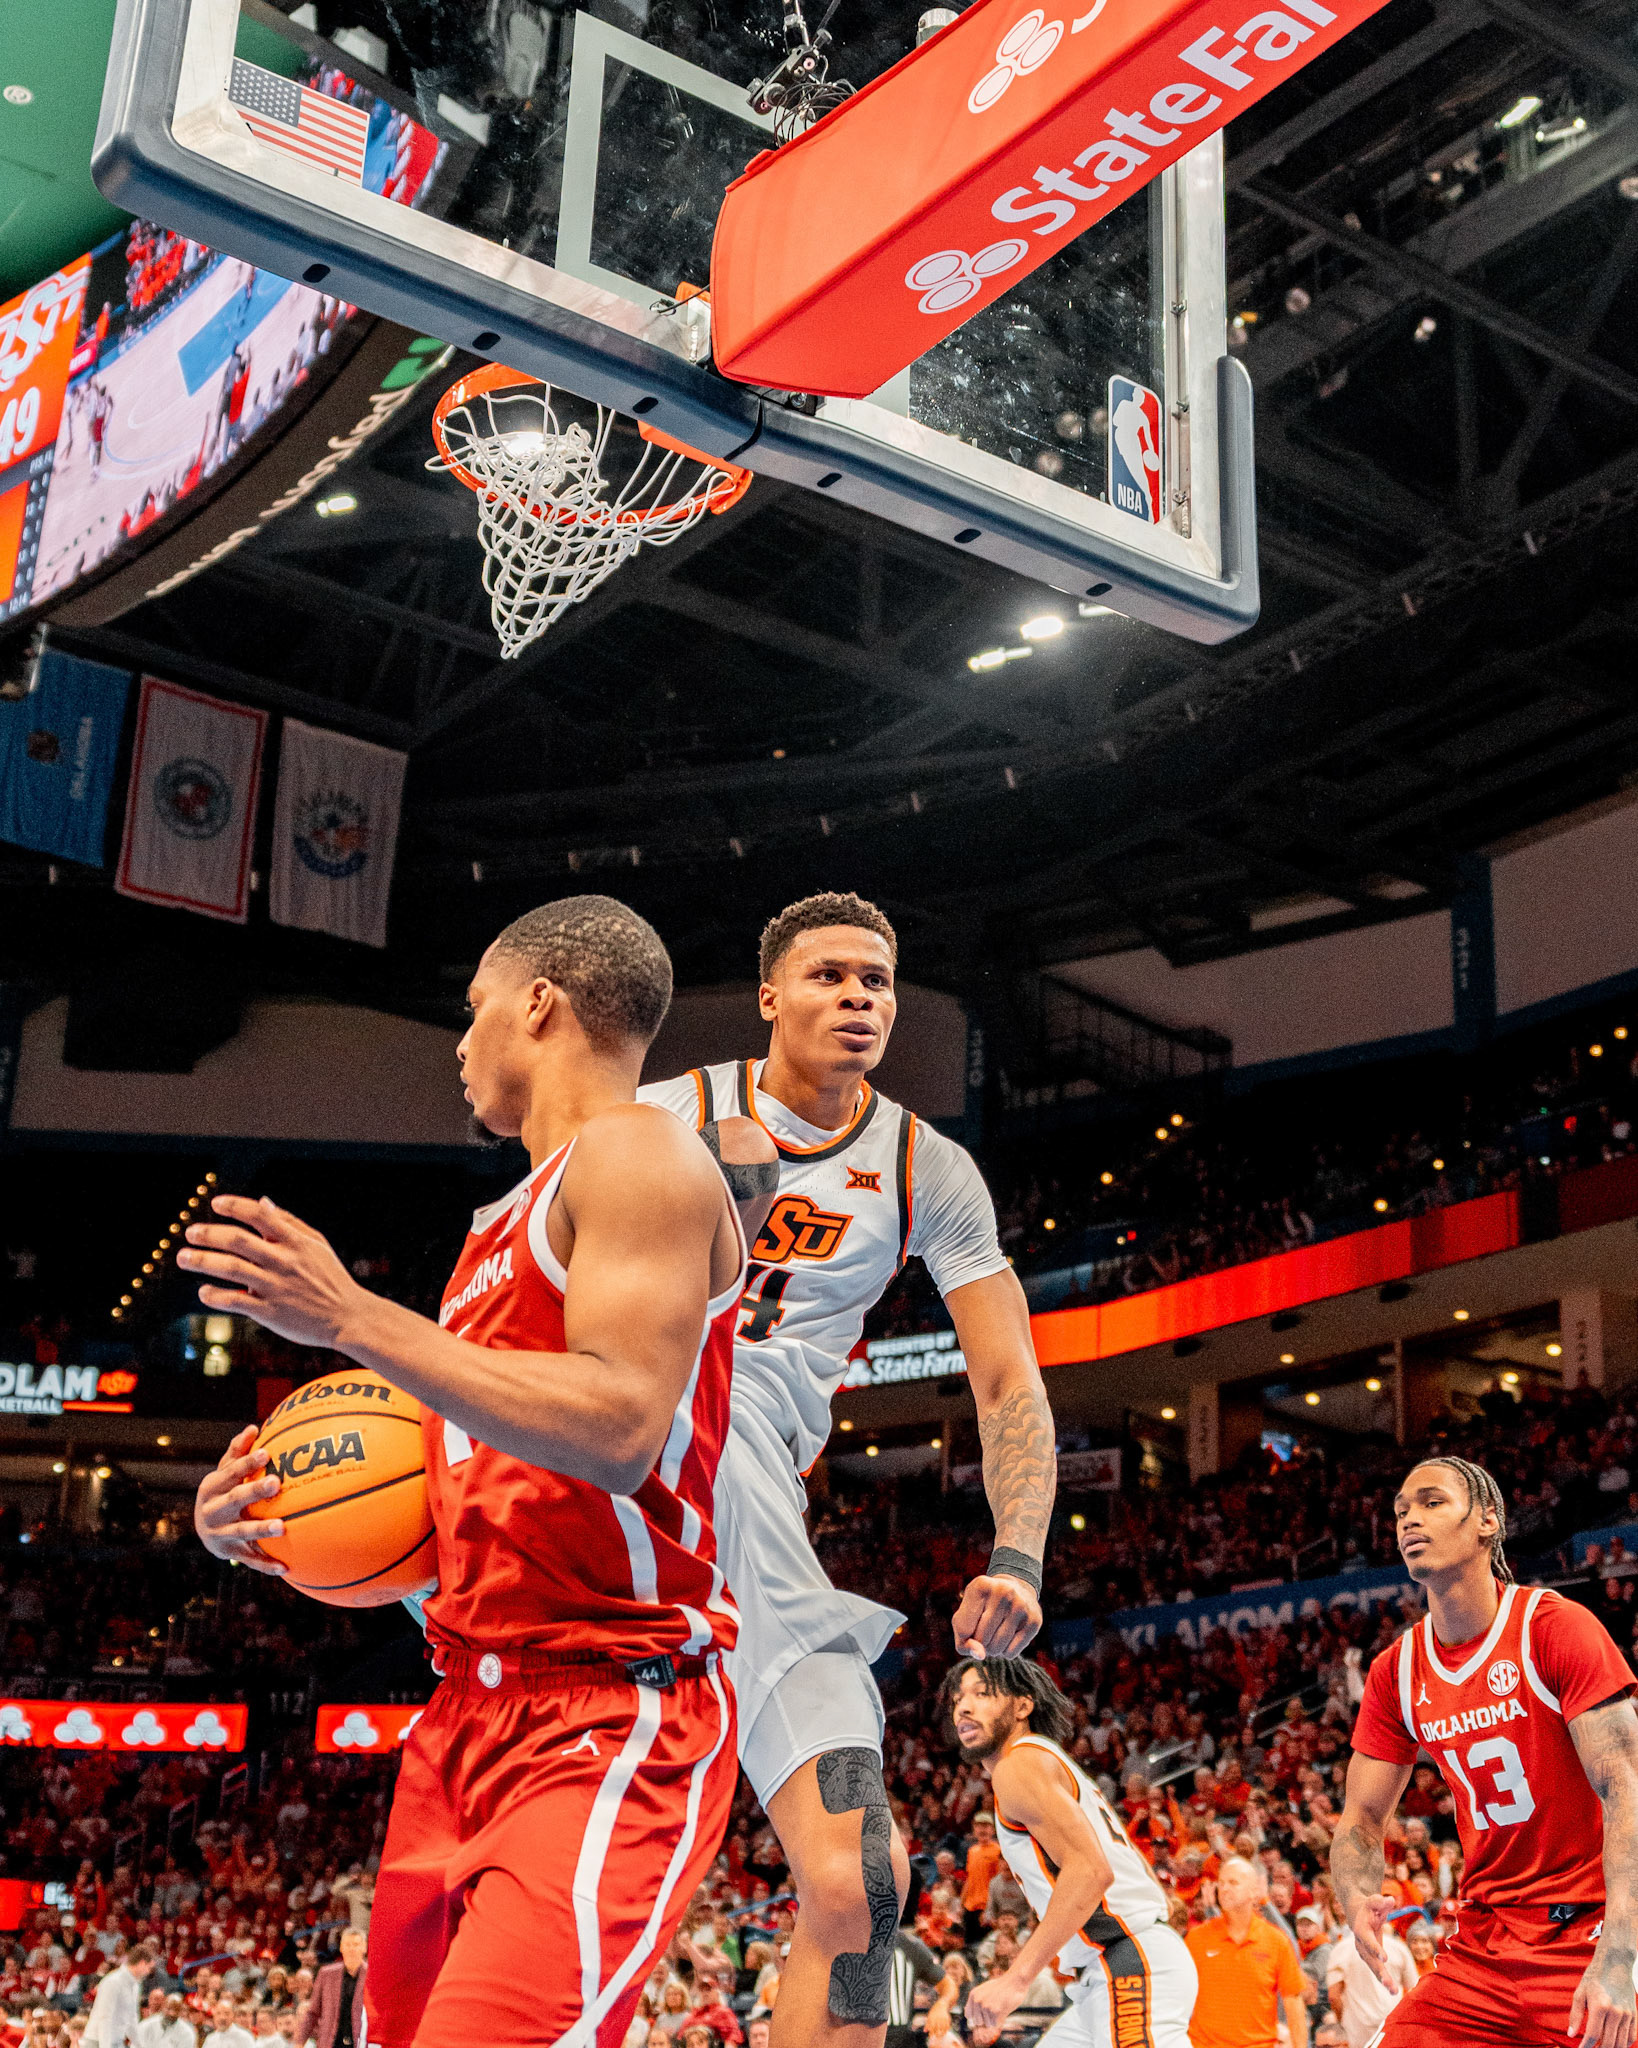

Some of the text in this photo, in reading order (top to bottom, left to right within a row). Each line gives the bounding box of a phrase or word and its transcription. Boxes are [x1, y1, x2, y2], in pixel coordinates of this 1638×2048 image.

[0, 386, 41, 464] 49
[1117, 483, 1143, 514] NBA
[848, 1170, 881, 1191] XII
[935, 1330, 957, 1351] BY
[871, 1349, 968, 1384] StateFarm
[265, 1431, 365, 1484] NCAA
[641, 1666, 659, 1681] 44
[1488, 1661, 1520, 1694] SEC
[1420, 1698, 1528, 1743] OKLAHOMA
[1442, 1736, 1536, 1831] 13
[1114, 1974, 1146, 2048] WBOYS
